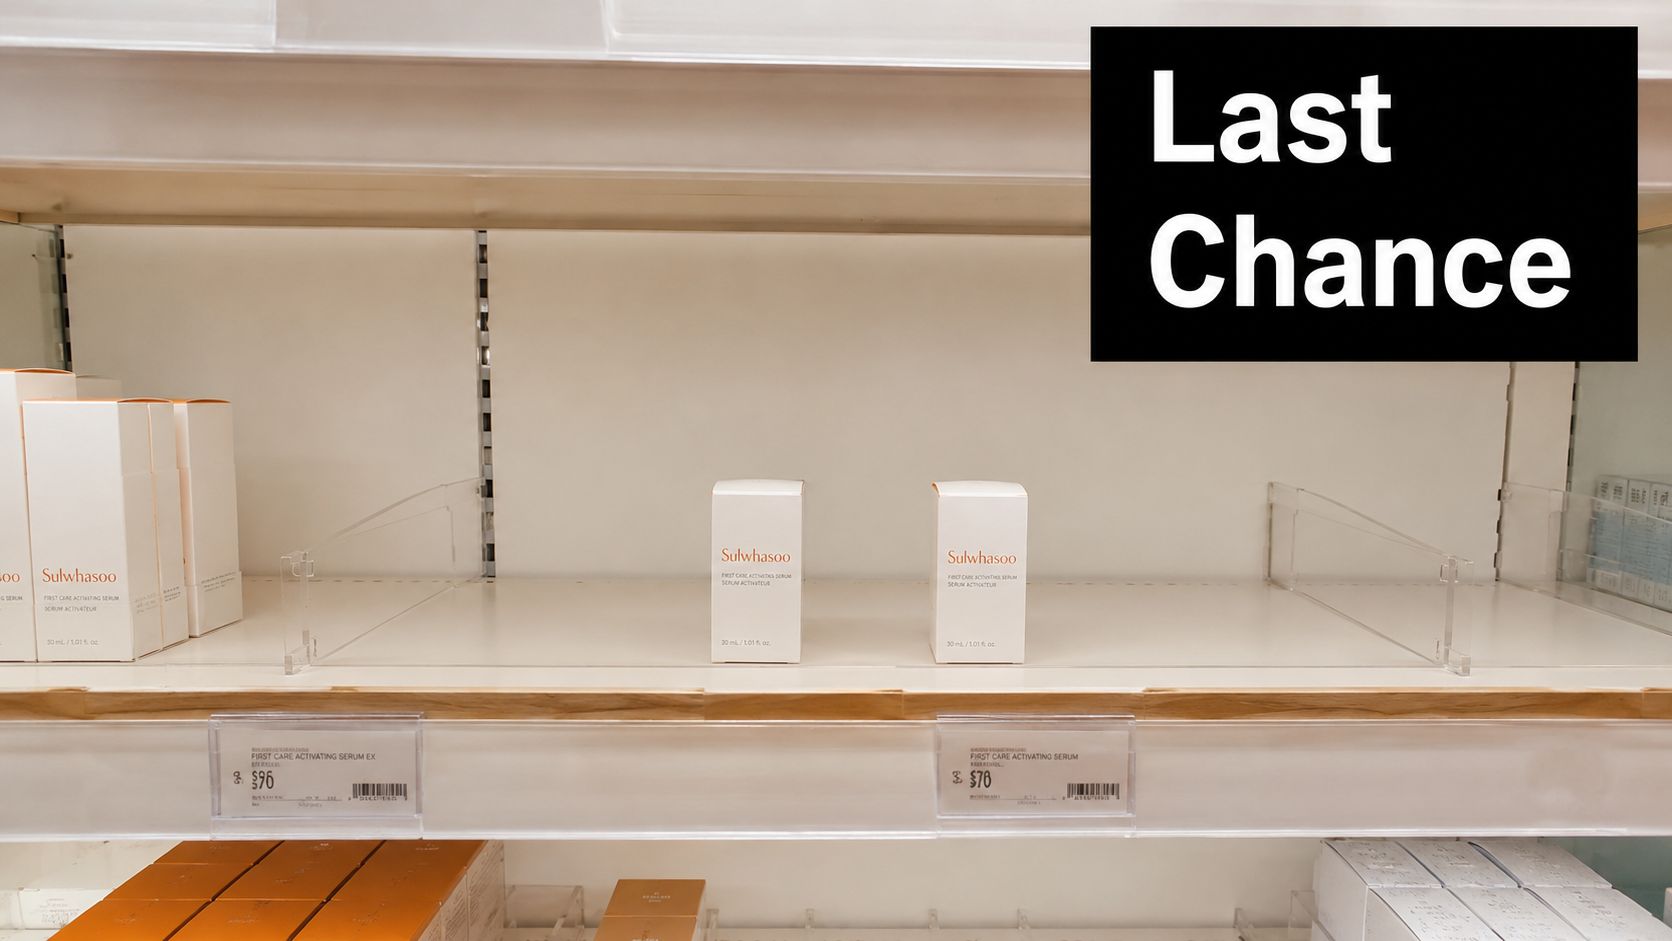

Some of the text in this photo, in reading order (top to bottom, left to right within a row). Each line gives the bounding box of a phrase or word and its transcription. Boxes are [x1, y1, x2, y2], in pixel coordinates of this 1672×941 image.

[721, 548, 791, 562] Sulwhasoo
[948, 550, 1017, 564] Sulwhasoo
[42, 568, 116, 582] Sulwhasoo
